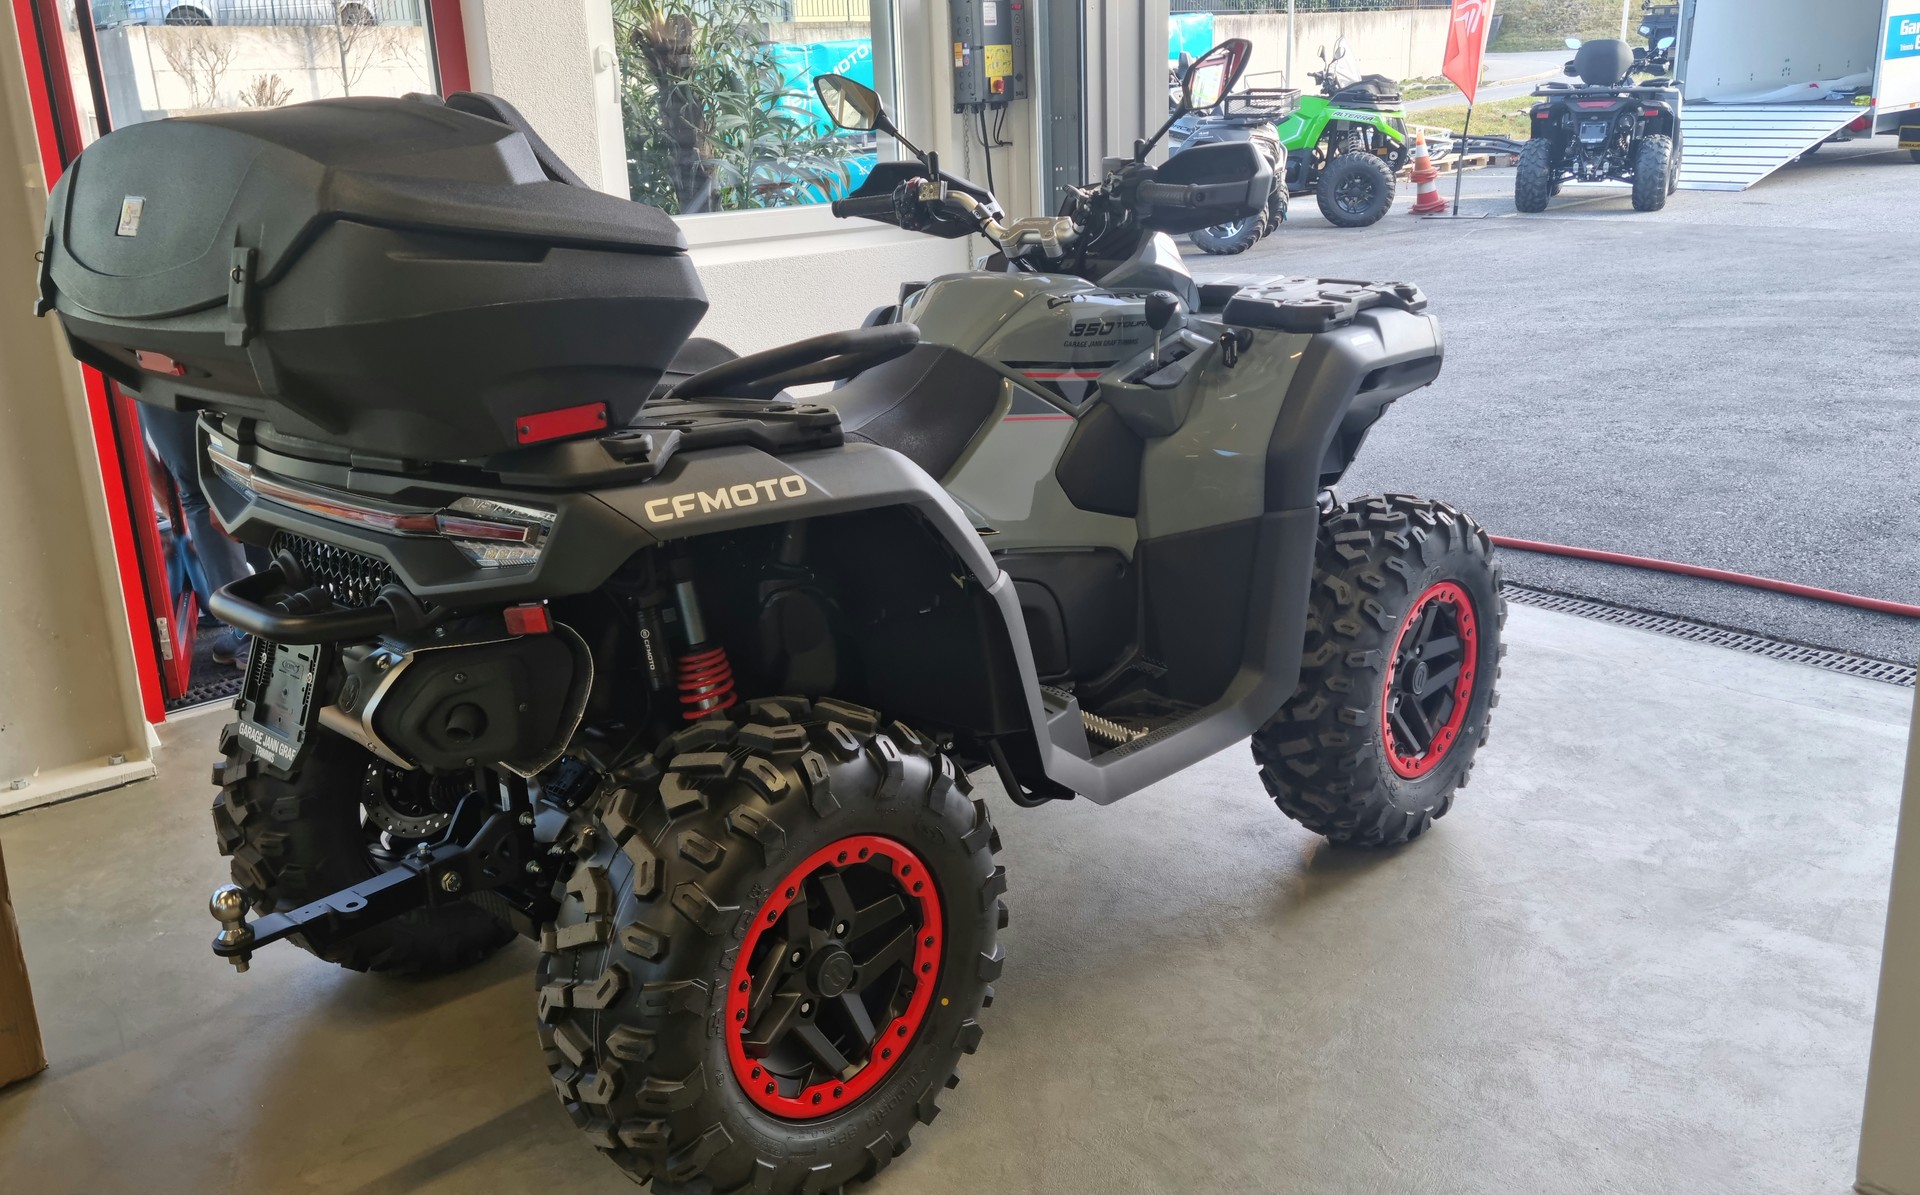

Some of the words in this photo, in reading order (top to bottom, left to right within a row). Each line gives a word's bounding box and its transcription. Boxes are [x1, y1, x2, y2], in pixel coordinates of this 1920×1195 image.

[1333, 111, 1374, 121] ALTERRA
[1069, 321, 1116, 336] 950
[1063, 340, 1088, 348] GARAGE
[645, 474, 807, 523] CFMOTO
[644, 639, 656, 671] CFMOTO
[238, 722, 264, 745] GARAGE
[262, 735, 280, 753] JANN
[278, 743, 297, 761] GRAF
